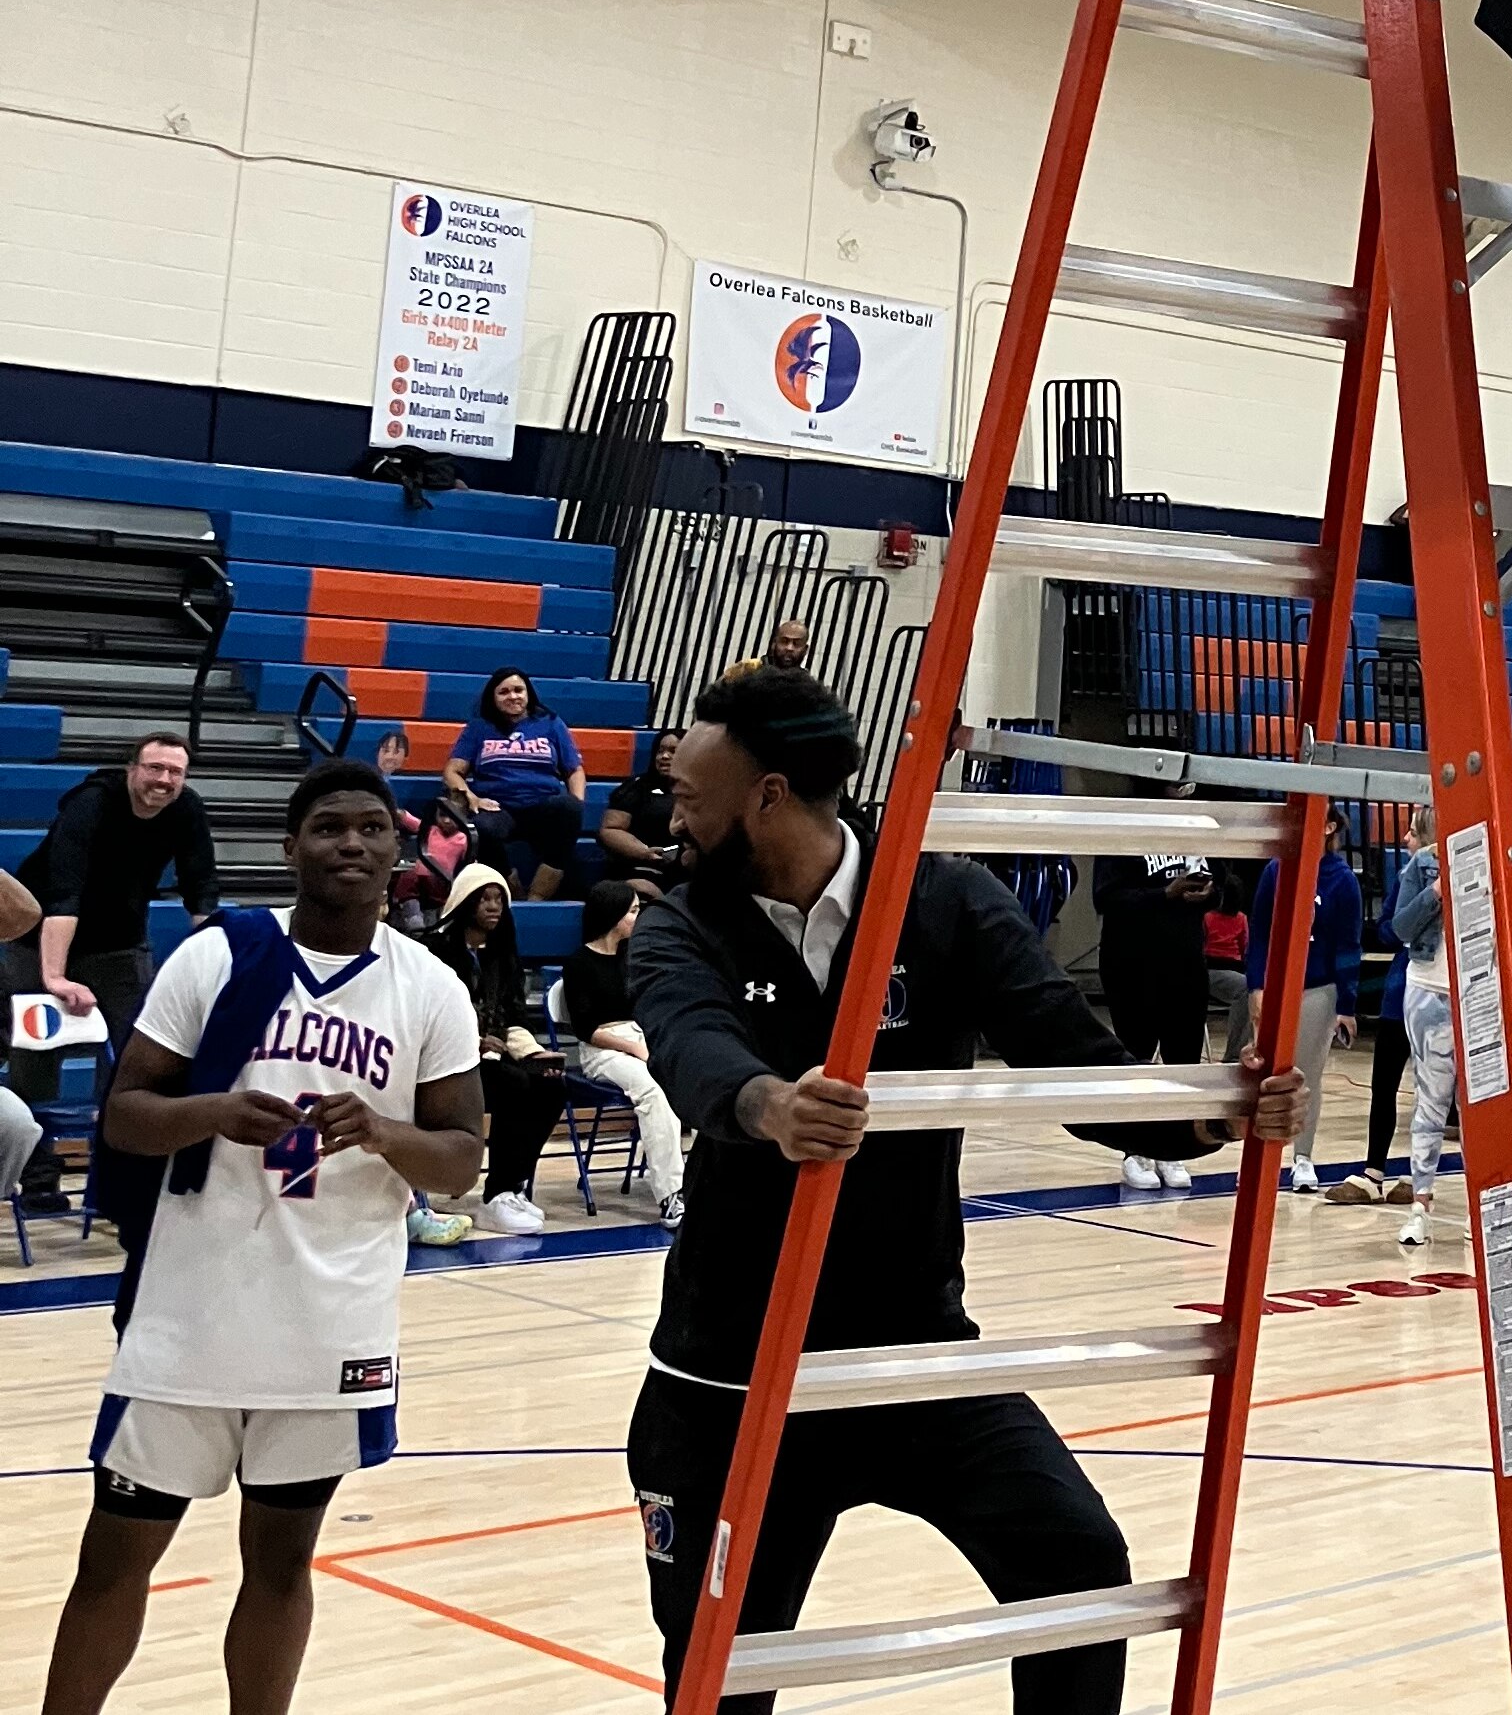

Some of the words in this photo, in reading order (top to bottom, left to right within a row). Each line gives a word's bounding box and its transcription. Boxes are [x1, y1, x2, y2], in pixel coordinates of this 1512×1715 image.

[450, 201, 500, 219] OVERLEA
[447, 216, 478, 231] HIGH
[480, 222, 527, 238] SCHOOL
[446, 231, 498, 248] FALCONS
[425, 251, 474, 272] MPSSAA
[479, 260, 494, 275] 2A
[410, 267, 440, 285] State
[445, 272, 507, 295] Champions
[418, 288, 490, 315] 2022
[709, 272, 776, 299] Overlea
[781, 286, 845, 312] Falcons
[850, 299, 934, 328] Basketball
[402, 309, 429, 326] Girls
[432, 314, 469, 332] 4x400
[473, 319, 507, 337] Meter
[427, 331, 459, 352] Relay
[463, 336, 480, 352] 2A
[412, 358, 437, 375] Temi
[411, 380, 455, 399] Deborah
[460, 386, 509, 405] Oyetunde
[409, 402, 451, 420] Mariam
[455, 408, 485, 424] Sanni
[406, 424, 447, 441] Nevaeh
[450, 428, 494, 447] Frierson
[481, 738, 552, 758] BEARS
[263, 1092, 324, 1199] 4
